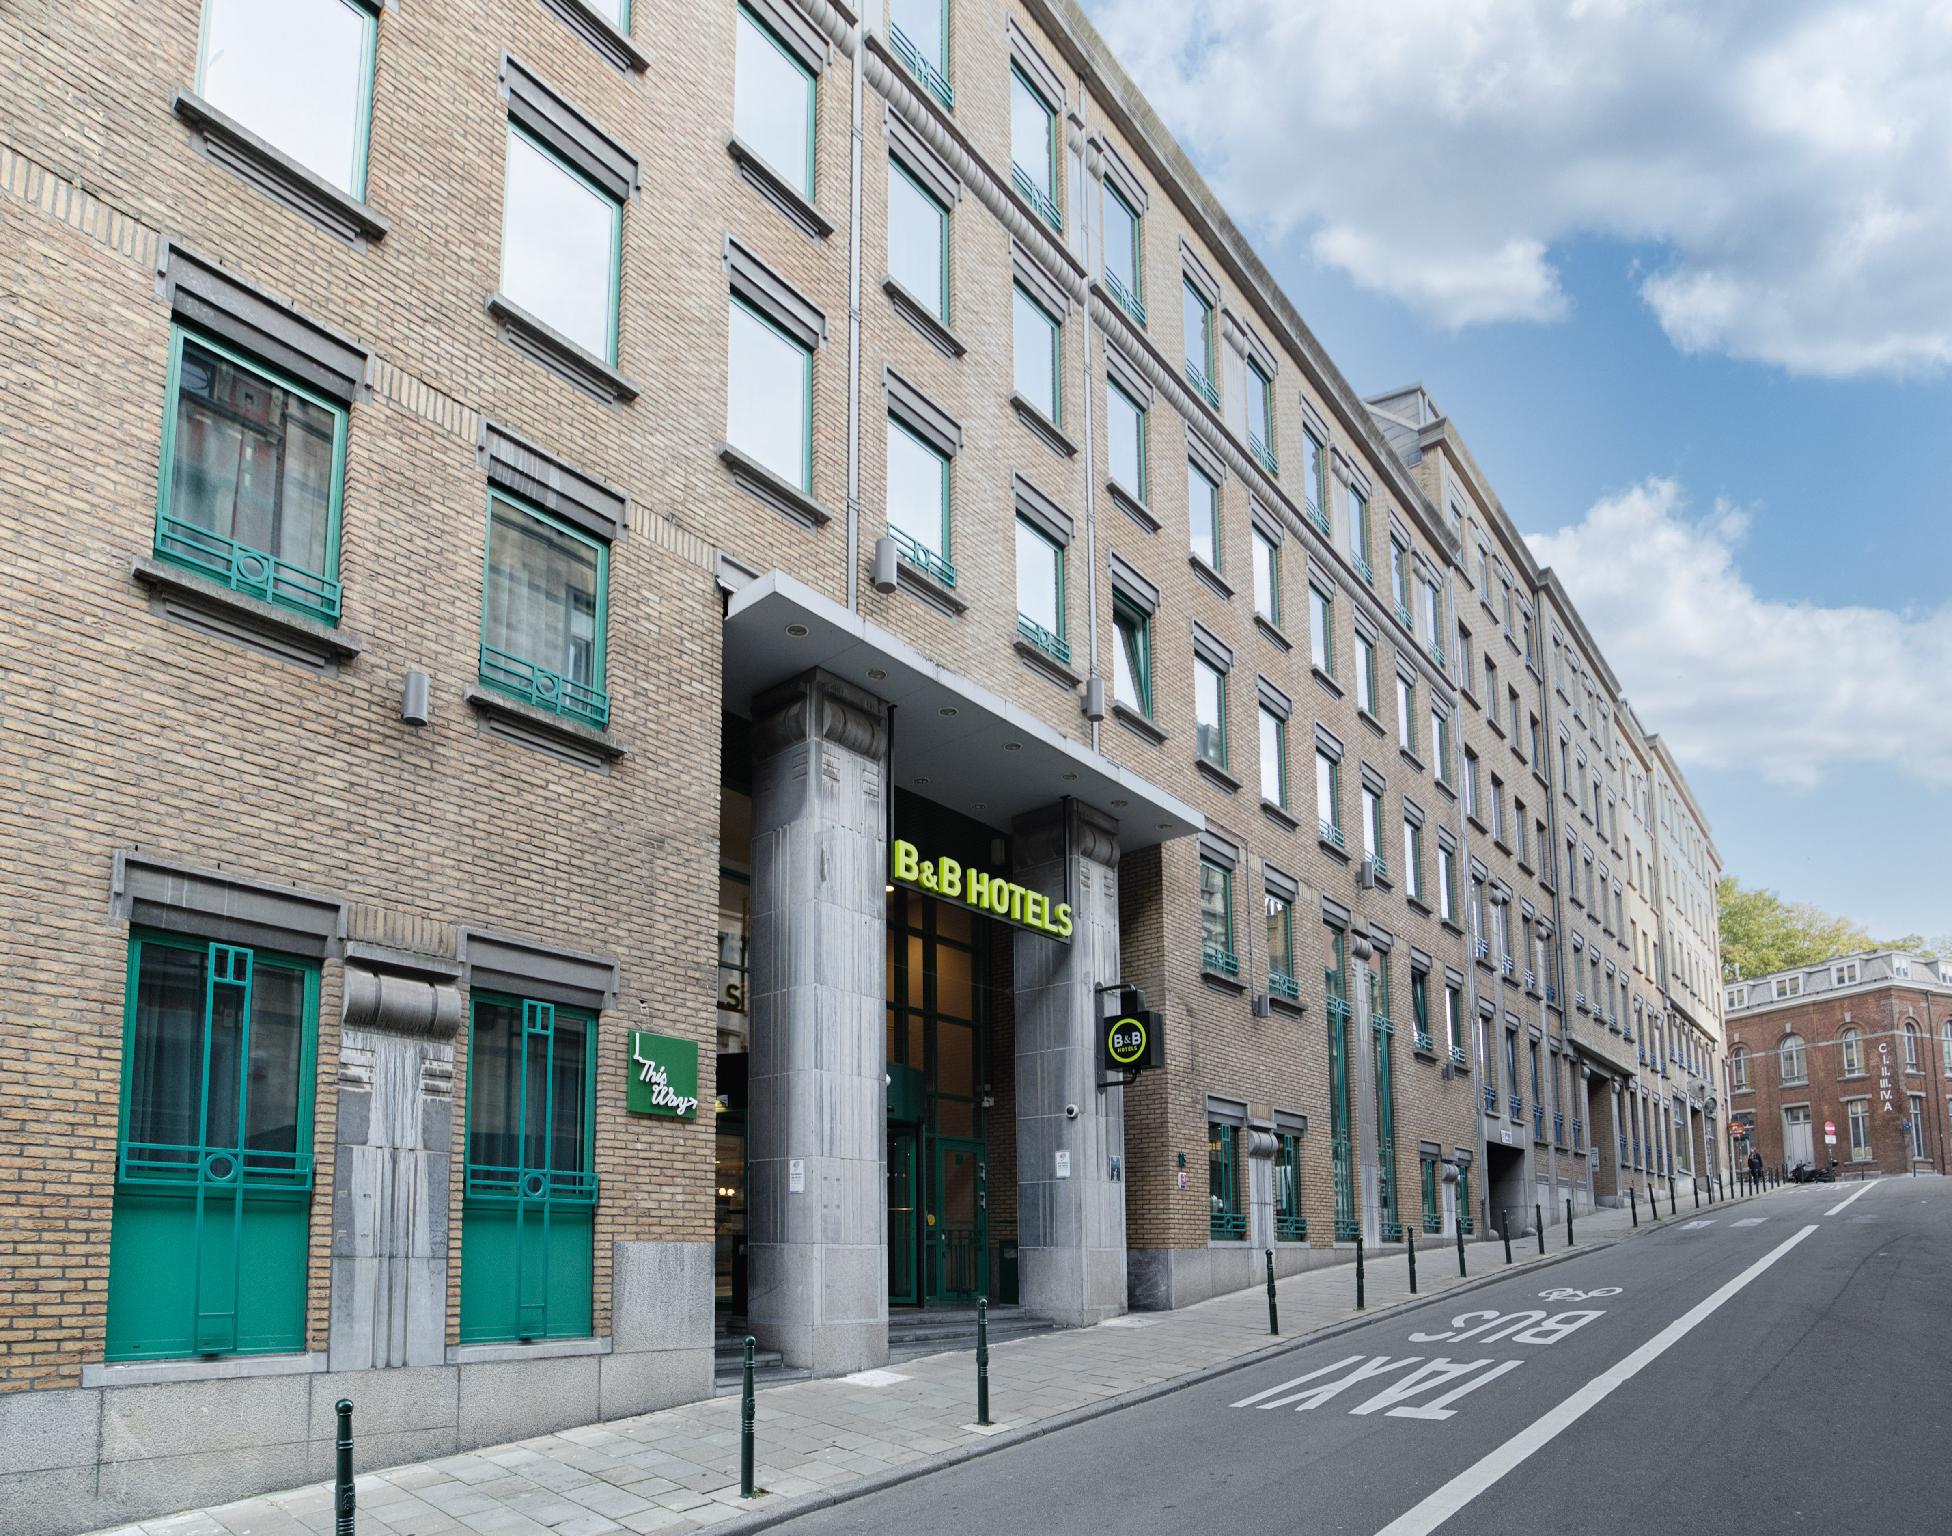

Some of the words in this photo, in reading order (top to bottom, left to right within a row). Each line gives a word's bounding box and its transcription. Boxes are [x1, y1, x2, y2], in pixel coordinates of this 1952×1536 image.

[895, 840, 961, 897] B&B
[967, 868, 1072, 937] HOTELS
[720, 984, 740, 1009] S
[1114, 1031, 1141, 1048] B&B
[639, 1059, 667, 1085] This
[652, 1084, 692, 1115] Way
[1408, 1310, 1608, 1345] BUS
[1228, 1355, 1526, 1420] TAXI
